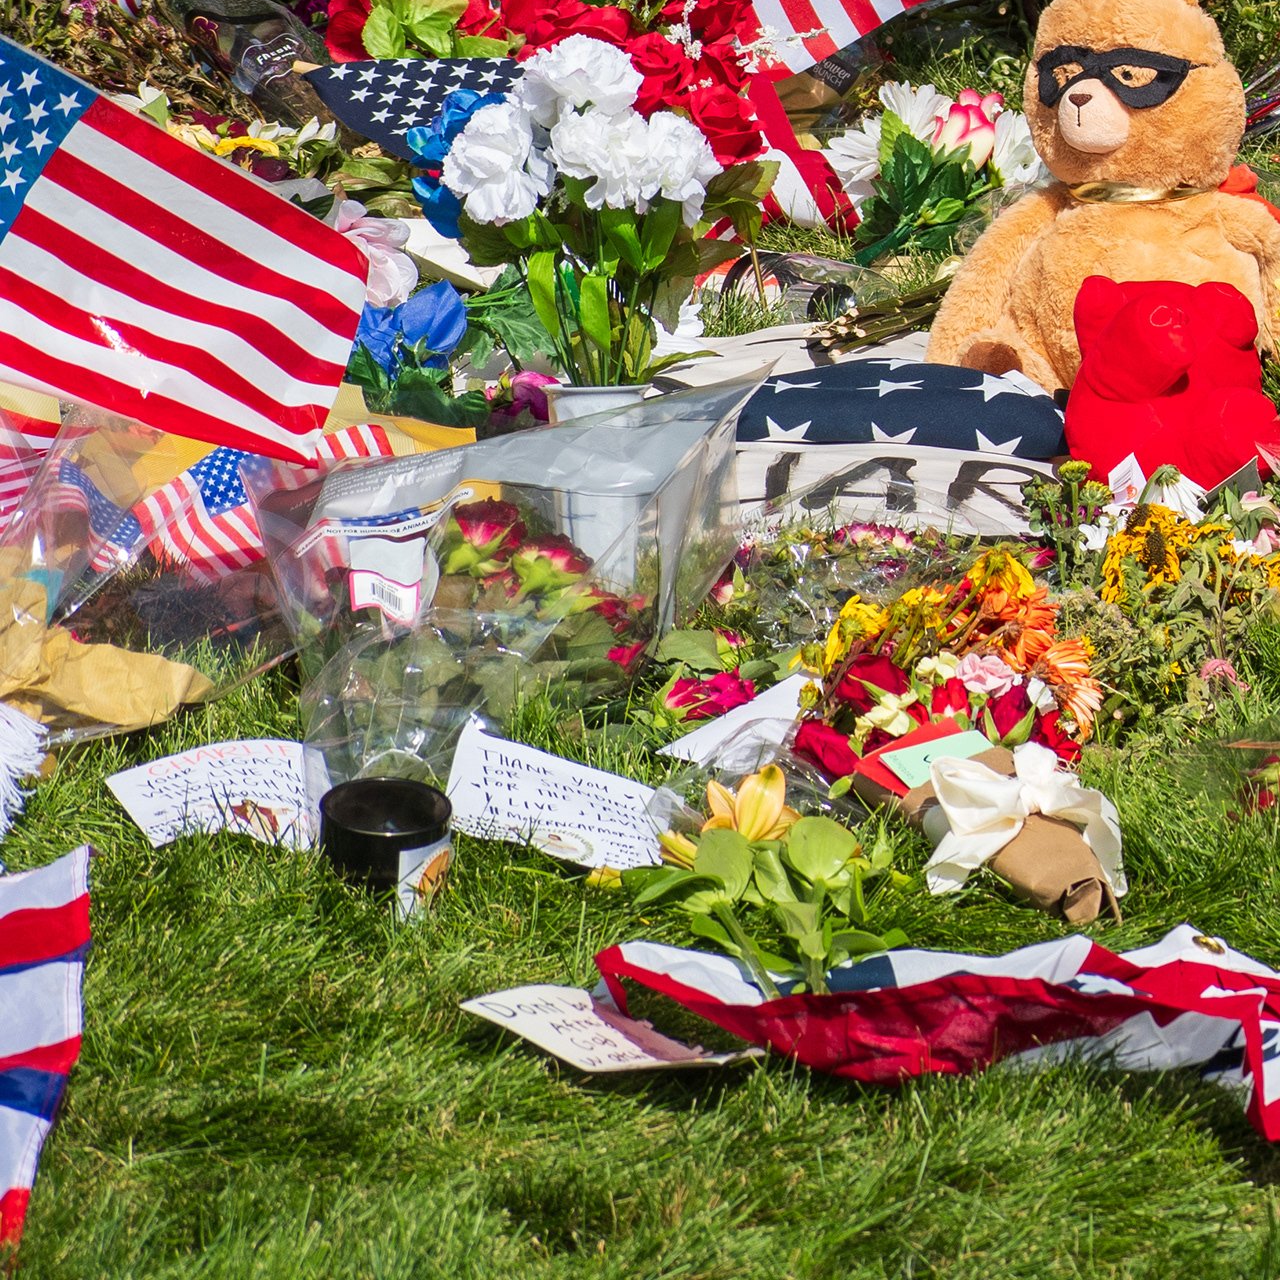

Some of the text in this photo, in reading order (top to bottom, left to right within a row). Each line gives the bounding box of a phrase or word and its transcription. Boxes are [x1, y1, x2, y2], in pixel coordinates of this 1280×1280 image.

[813, 65, 843, 87] BUNCH
[402, 519, 429, 533] ANIMAL
[148, 744, 296, 777] CHARLIE
[208, 756, 294, 770] LEGACY
[477, 746, 555, 776] THANK
